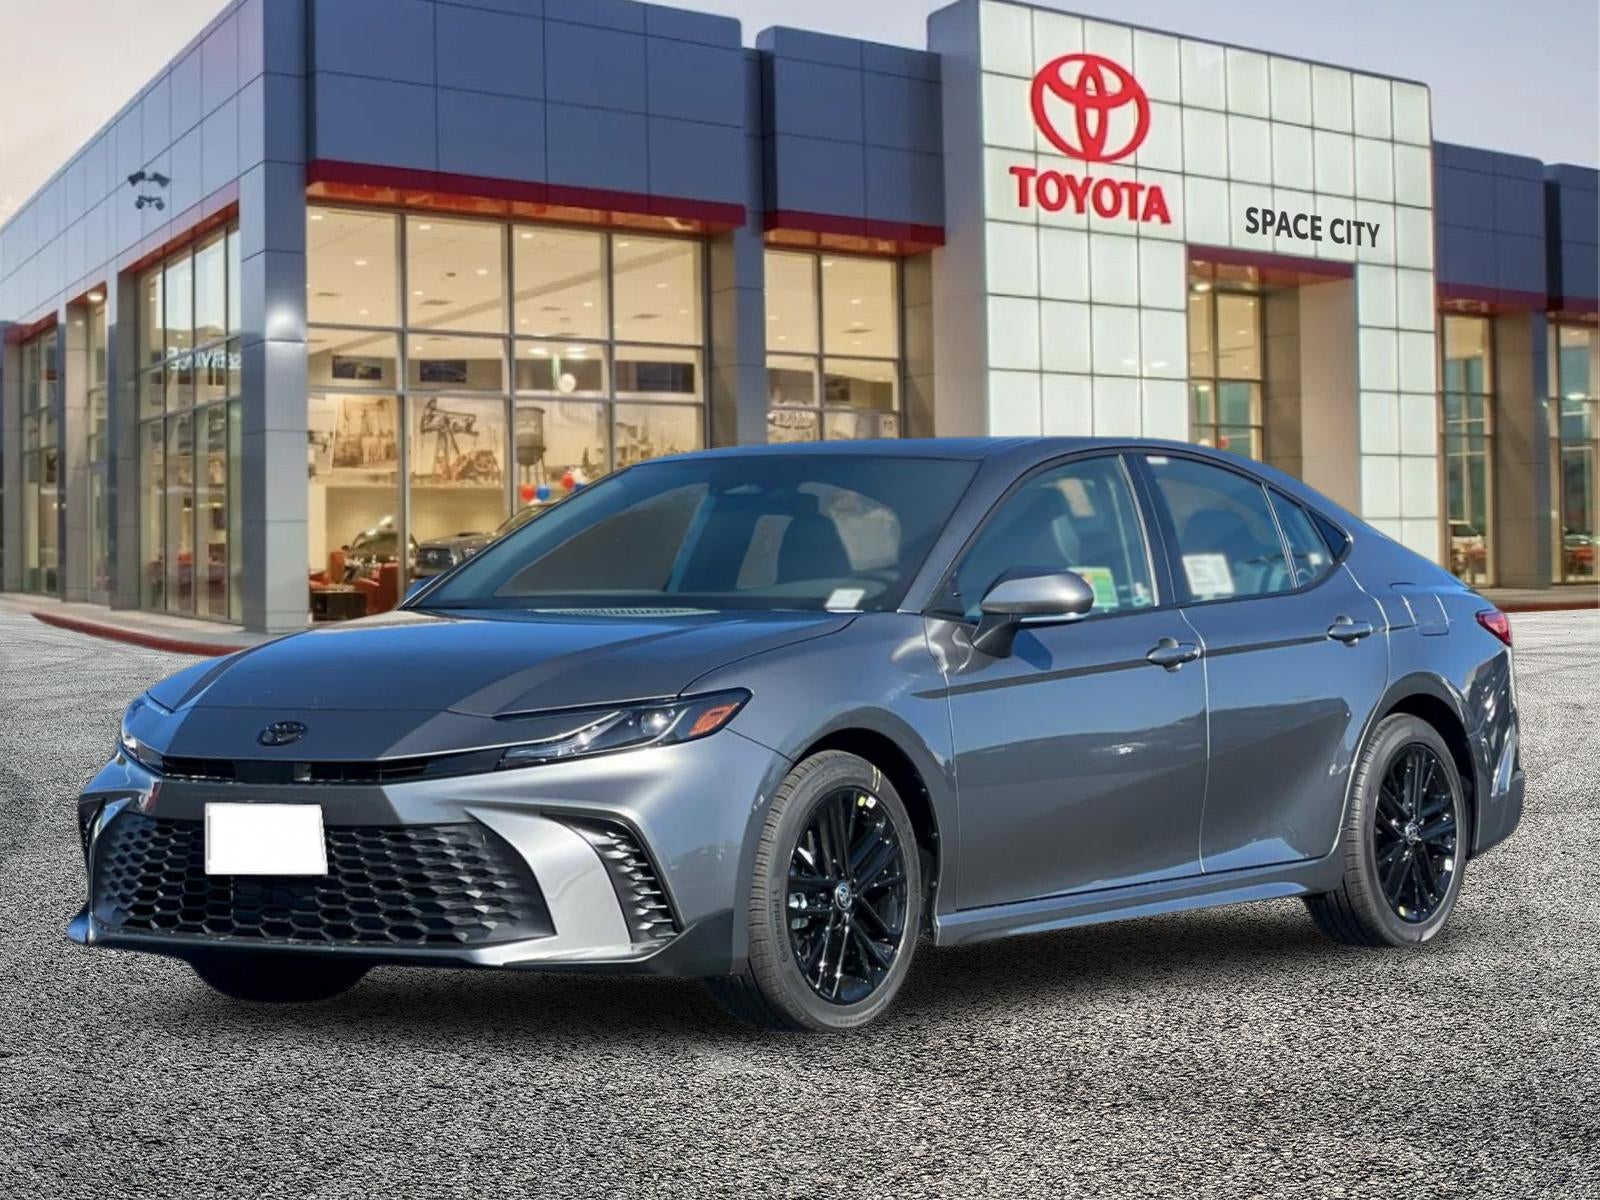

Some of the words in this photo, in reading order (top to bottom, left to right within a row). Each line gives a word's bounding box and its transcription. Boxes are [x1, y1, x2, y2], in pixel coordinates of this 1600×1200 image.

[1009, 166, 1171, 224] TOYOTA
[1245, 206, 1323, 242] SPACE
[1329, 218, 1381, 248] CITY
